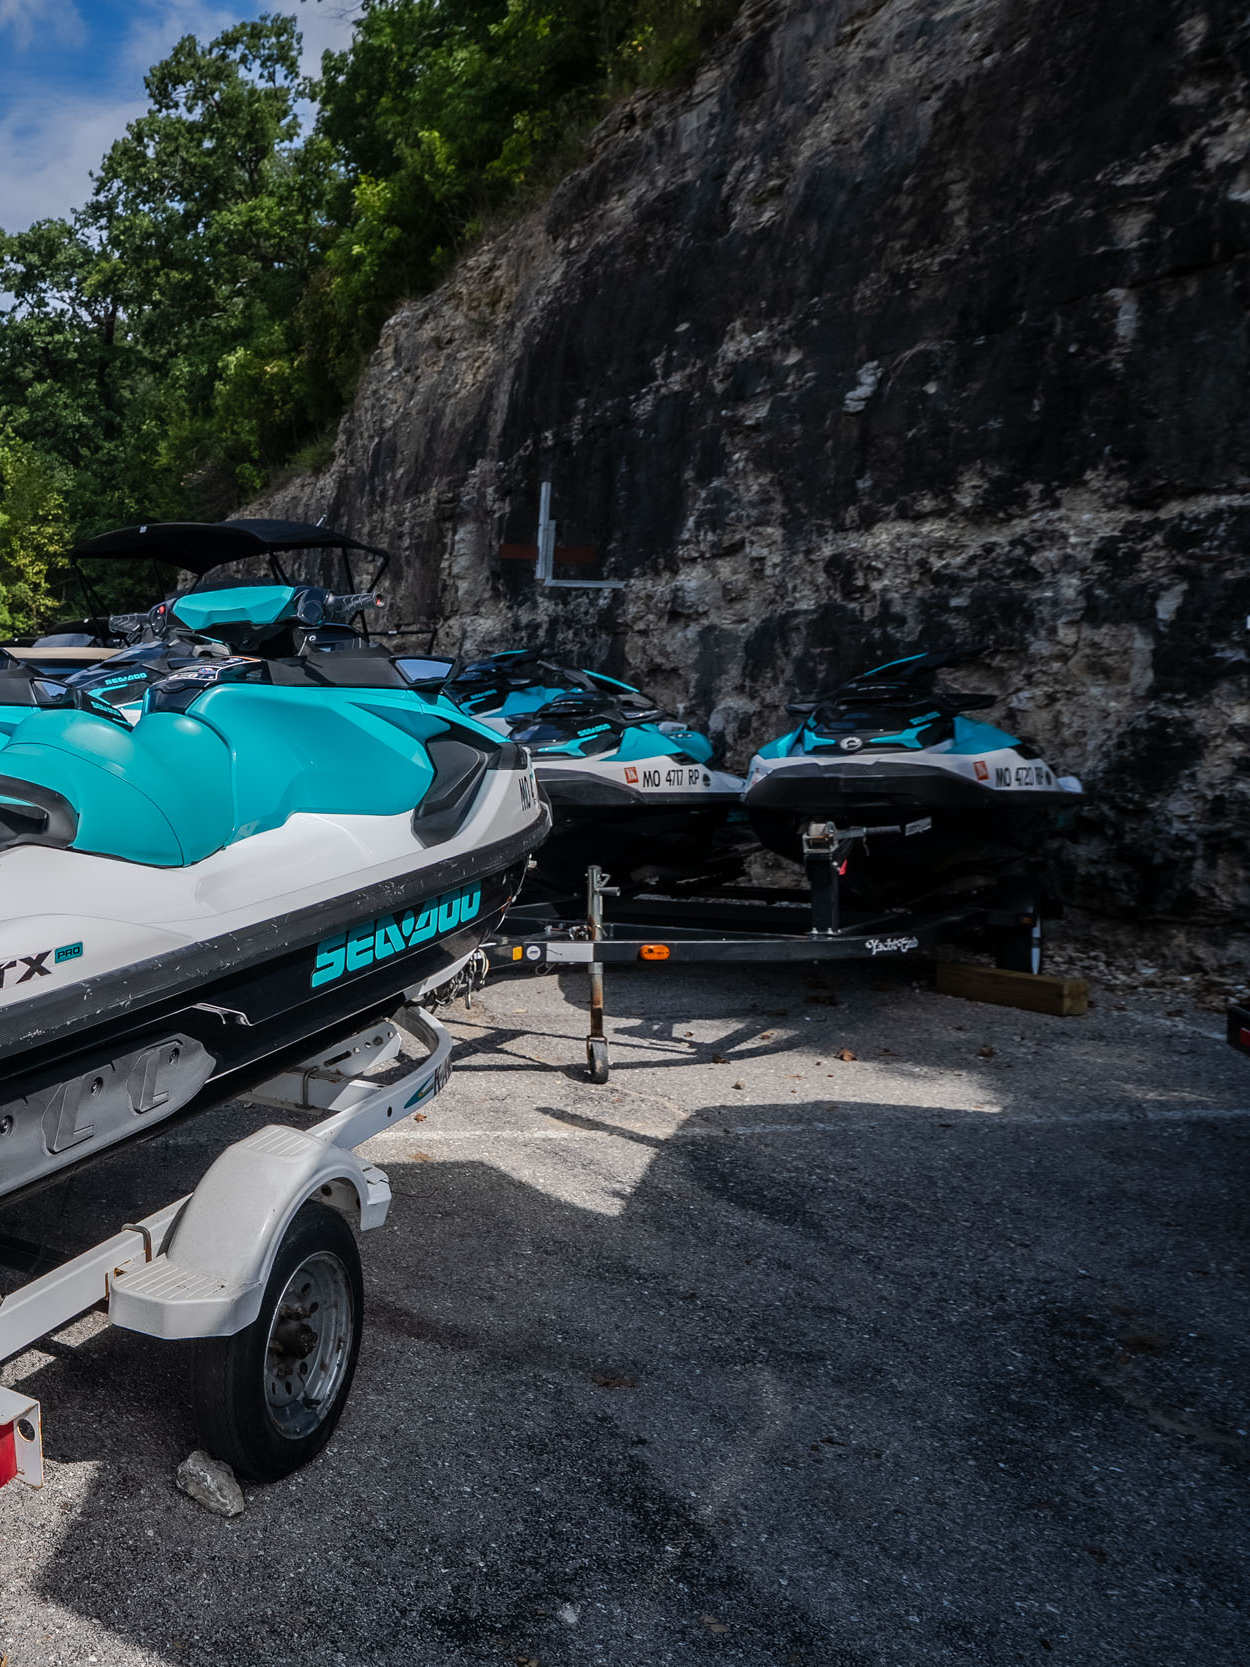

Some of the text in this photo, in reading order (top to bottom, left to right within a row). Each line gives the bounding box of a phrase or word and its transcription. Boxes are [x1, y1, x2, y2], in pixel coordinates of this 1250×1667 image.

[643, 770, 661, 788] MO
[665, 769, 684, 786] 4717
[688, 769, 700, 785] RP
[56, 944, 82, 961] PRO
